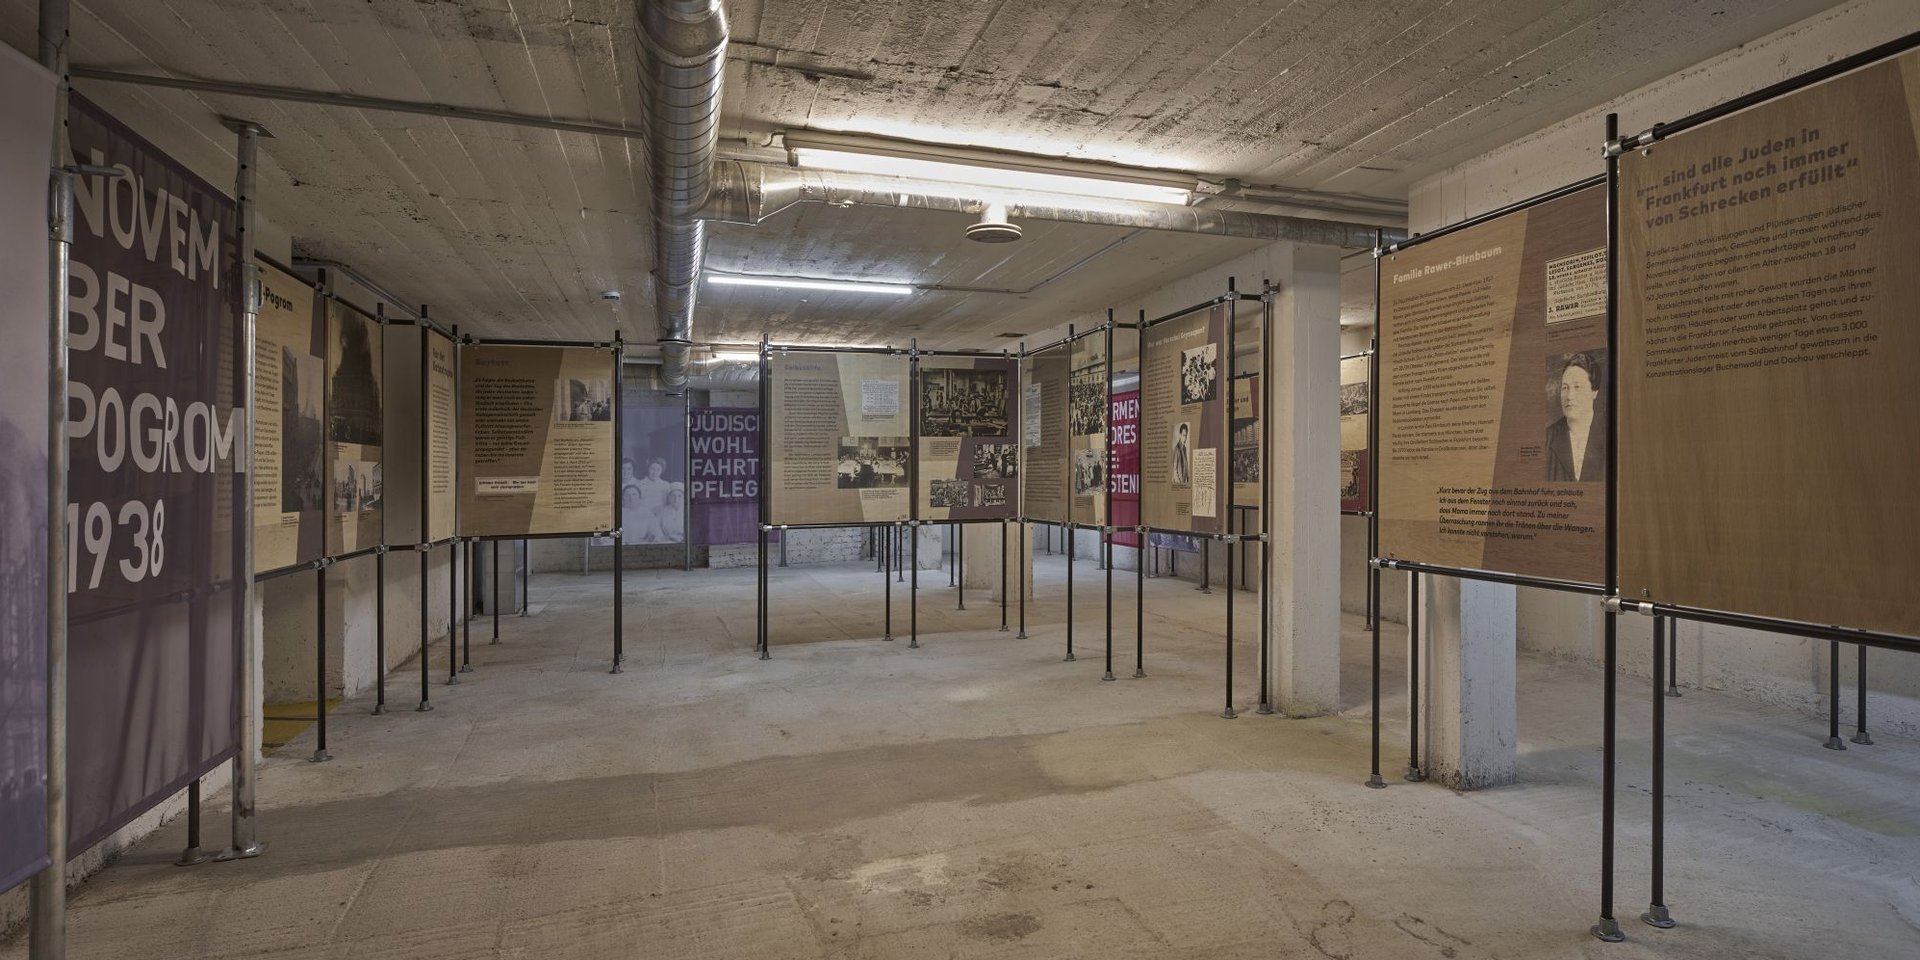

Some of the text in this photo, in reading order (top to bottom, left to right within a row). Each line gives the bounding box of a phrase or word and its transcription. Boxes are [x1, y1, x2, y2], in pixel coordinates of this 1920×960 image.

[1662, 164, 1696, 187] sind
[1701, 154, 1733, 175] alle
[1738, 136, 1796, 164] Juden
[1801, 128, 1820, 145] in
[1646, 141, 1849, 210] Frankfurt noch immer
[1645, 158, 1859, 229] von Schrecken erfüllt“
[73, 147, 219, 289] NOVEM
[1729, 234, 1769, 249] Geschäfte
[1772, 230, 1787, 240] und
[1790, 223, 1818, 236] Praxen
[1822, 213, 1861, 229] während
[1865, 209, 1880, 219] des
[1749, 223, 1764, 232] und
[1766, 209, 1823, 231] Plünderungen
[1826, 199, 1867, 217] jüdischer
[1691, 271, 1712, 281] Juden
[1750, 261, 1759, 269] im
[1761, 257, 1781, 267] Alter
[1784, 249, 1822, 263] zwischen
[1838, 242, 1855, 252] und
[1714, 253, 1741, 267] begann
[1744, 249, 1760, 258] eine
[1762, 238, 1810, 257] mehrtägige
[1812, 225, 1872, 246] Verhaftungs-
[1393, 246, 1503, 284] Familie Rawer-Birnbaum
[1721, 290, 1733, 298] mit
[1758, 281, 1787, 292] Gewalt
[1789, 275, 1821, 286] wurden
[1823, 272, 1837, 281] die
[1839, 265, 1875, 278] Männer
[1679, 283, 1712, 294] betroffen
[1702, 304, 1724, 313] Nacht
[1726, 300, 1742, 309] oder
[1745, 298, 1758, 306] den
[1761, 291, 1798, 303] nächsten
[1801, 286, 1826, 299] Tagen
[1848, 279, 1871, 289] ihren
[68, 259, 168, 369] BER
[1556, 302, 1579, 312] RAWER
[1688, 327, 1729, 339] Frankfurter
[1731, 322, 1766, 333] Festhalle
[1768, 316, 1808, 330] gebracht.
[1810, 313, 1827, 322] Von
[1829, 308, 1862, 319] diesem
[1719, 314, 1736, 322] oder
[1757, 303, 1806, 319] Arbeitsplatz
[1809, 298, 1837, 311] geholt
[1840, 295, 1857, 304] und
[1707, 351, 1728, 359] meist
[1749, 343, 1797, 354] Südbahnhof
[1800, 336, 1849, 351] gewaltsam
[1863, 333, 1877, 341] die
[1722, 335, 1757, 346] innerhalb
[1759, 331, 1790, 343] weniger
[1793, 328, 1813, 339] Tage
[1816, 325, 1838, 334] etwa
[1715, 359, 1761, 370] Buchenwald
[1763, 357, 1778, 365] und
[1781, 354, 1813, 363] Dachau
[1816, 348, 1870, 362] verschleppt.
[68, 380, 245, 473] POGROM
[691, 410, 759, 432] JÜDISC
[691, 437, 754, 454] WOHL
[691, 459, 759, 476] FAHRT
[691, 480, 758, 498] PFLEG
[67, 499, 164, 593] 1938
